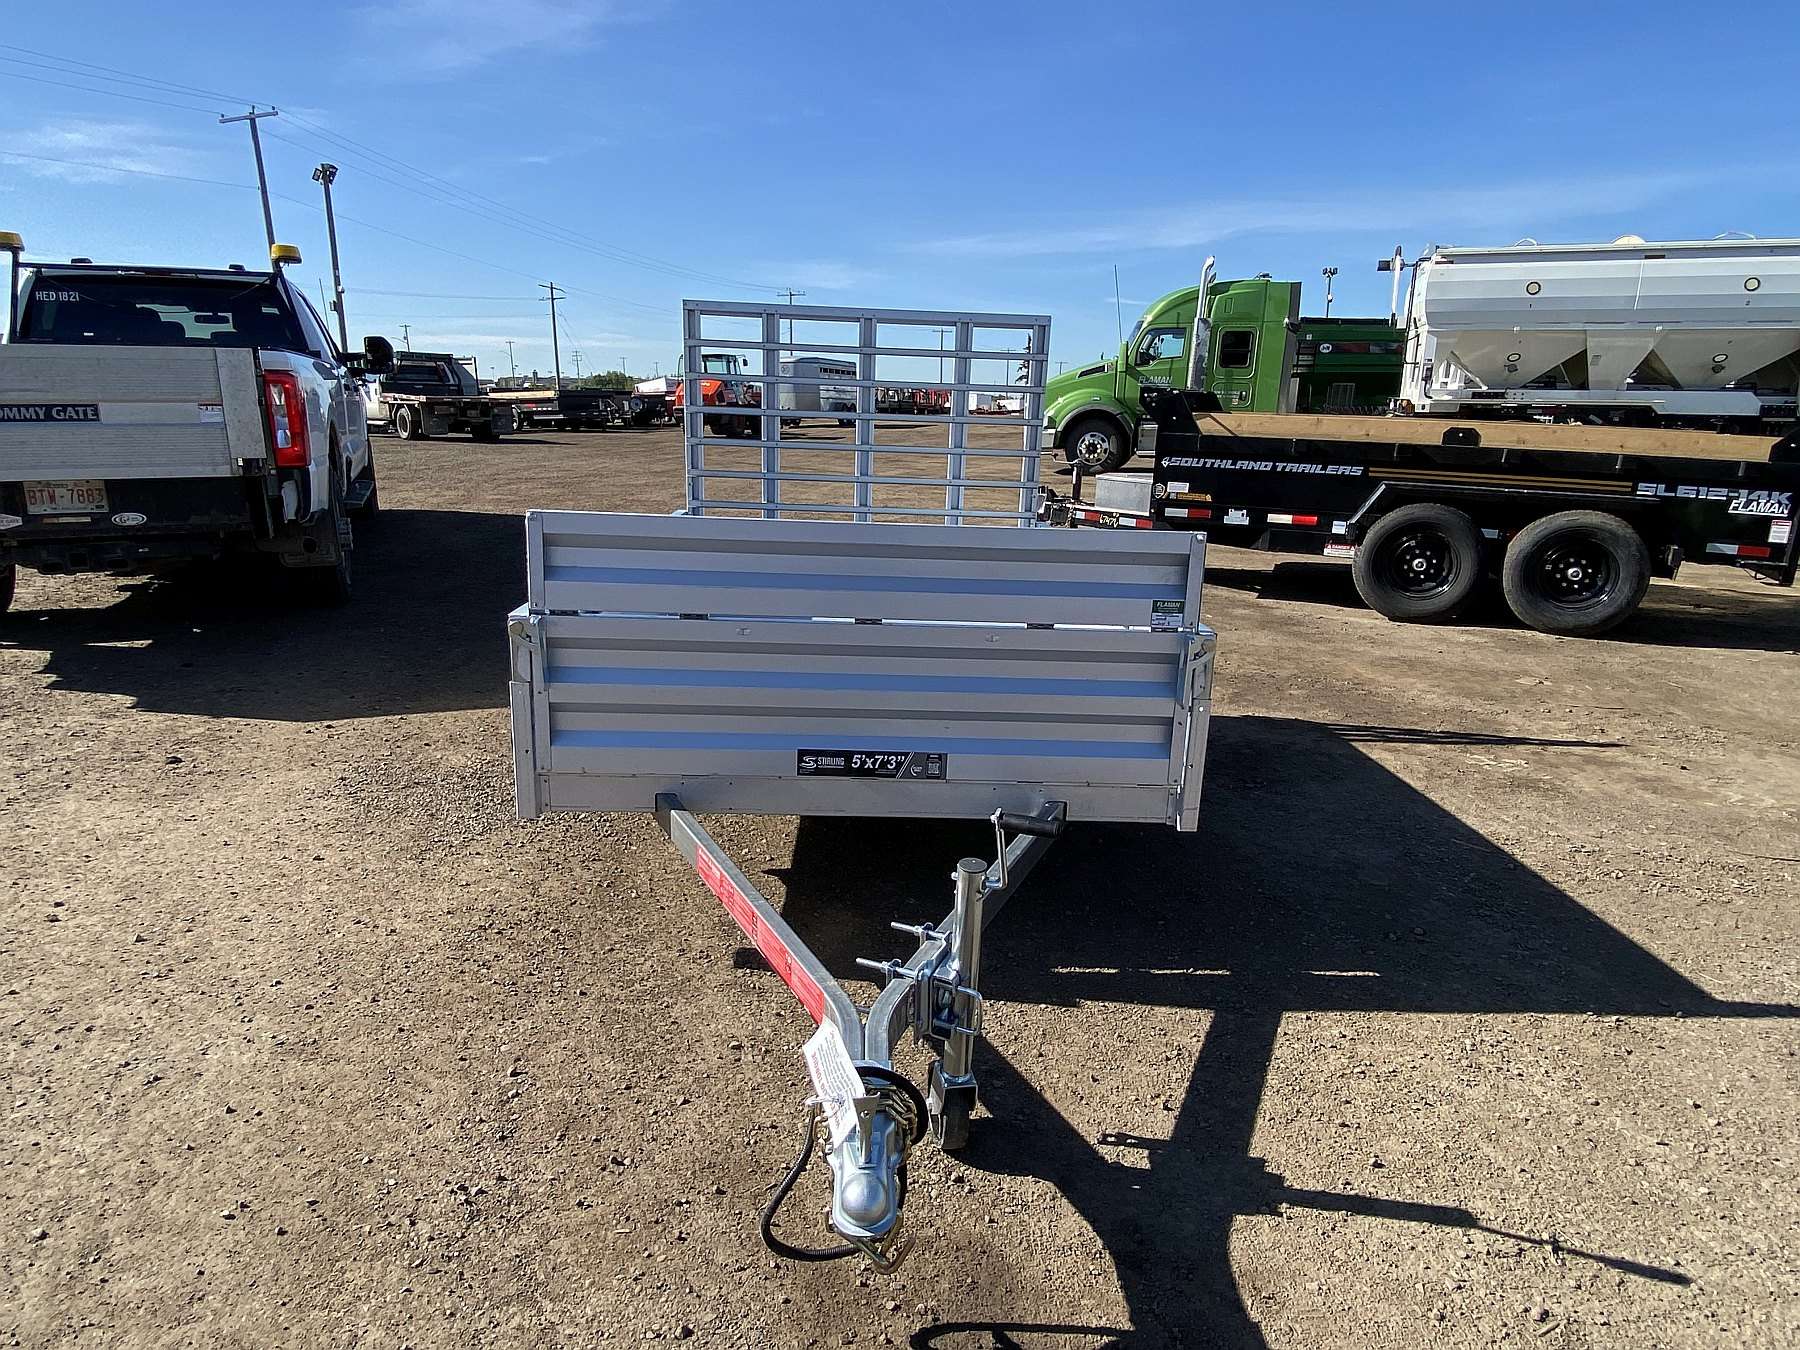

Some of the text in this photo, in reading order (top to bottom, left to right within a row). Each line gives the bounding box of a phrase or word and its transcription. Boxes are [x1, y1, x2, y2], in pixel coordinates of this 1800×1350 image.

[36, 291, 79, 301] HED 1821
[1139, 376, 1172, 384] FLAMAN
[52, 407, 97, 419] GATE
[1169, 457, 1364, 476] SOUTHLAND TRAILERS
[1729, 500, 1791, 515] FLAMAN
[818, 757, 844, 766] STIRLING
